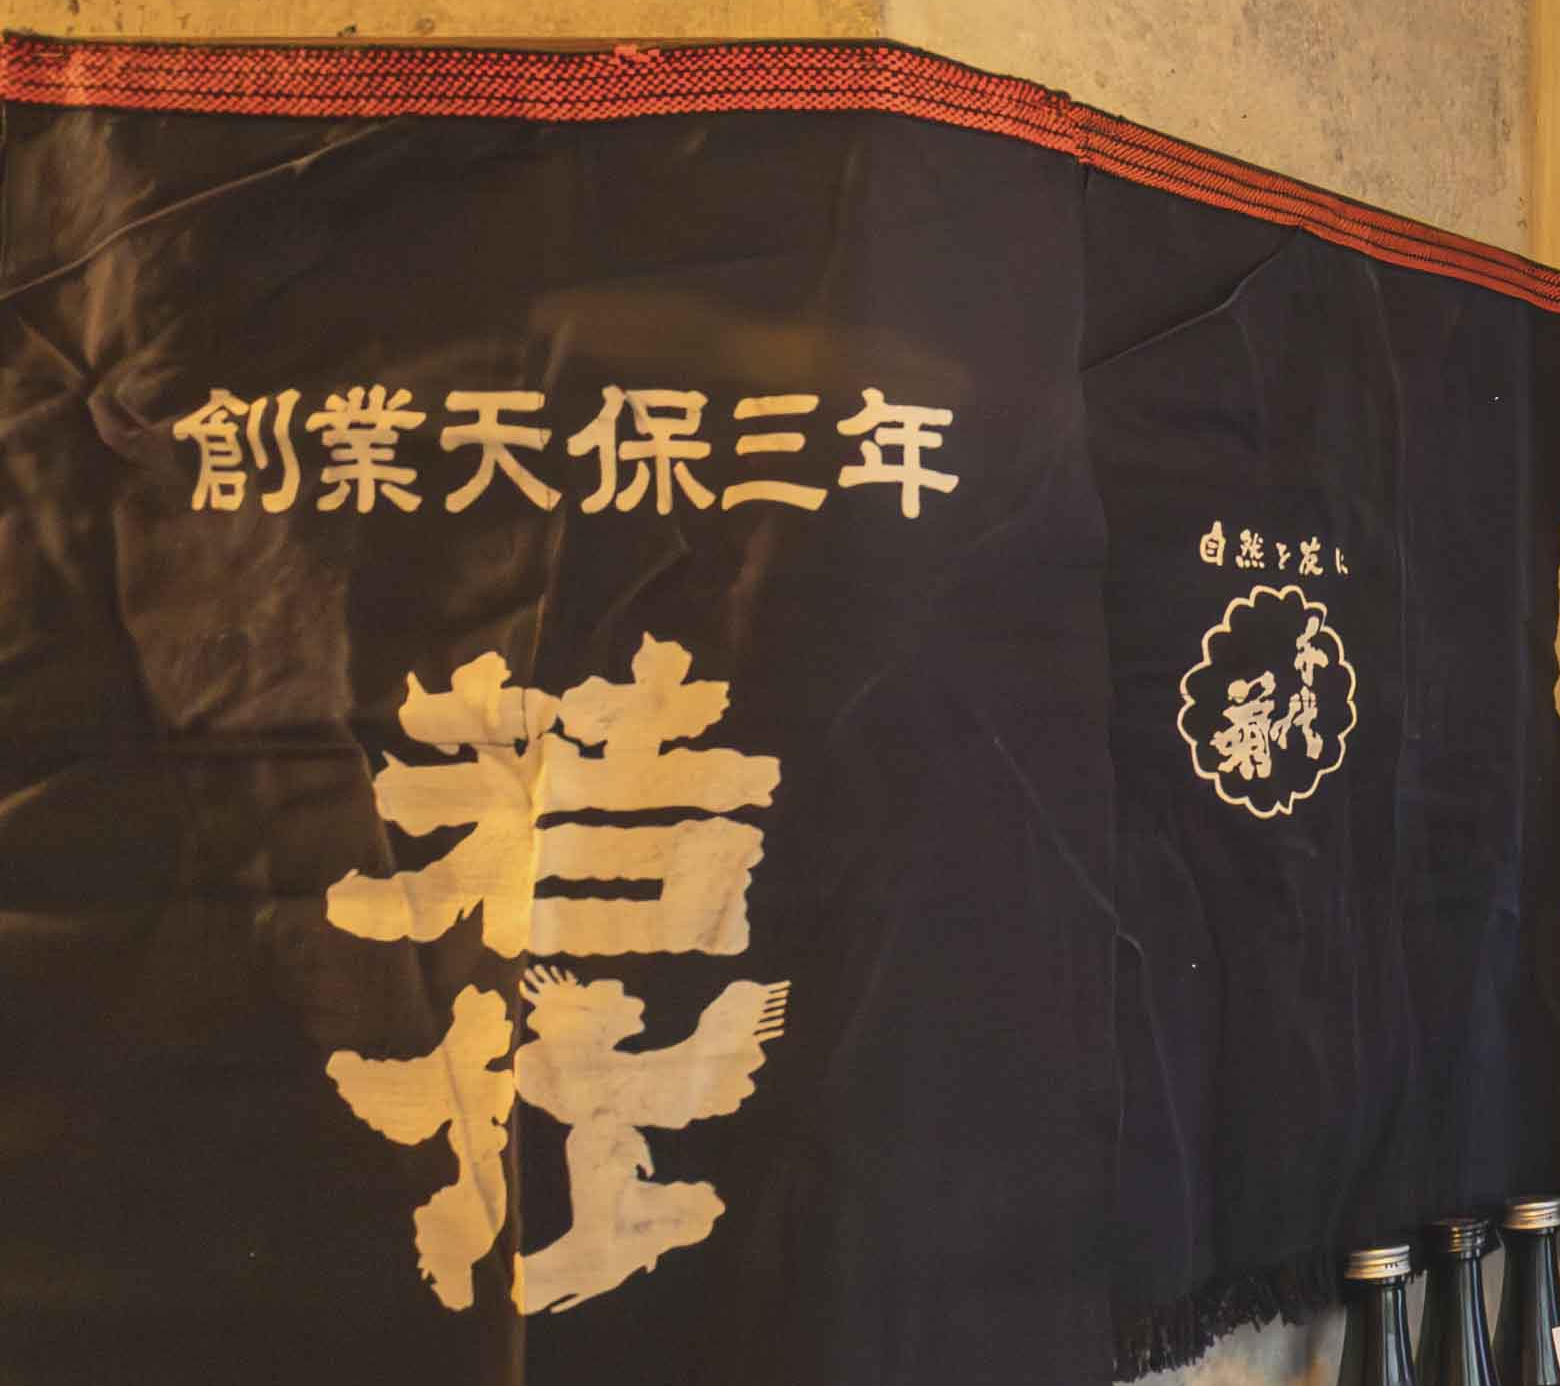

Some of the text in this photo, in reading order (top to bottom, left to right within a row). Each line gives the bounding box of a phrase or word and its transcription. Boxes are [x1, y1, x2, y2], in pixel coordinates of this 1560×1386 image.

[172, 387, 961, 518] 創業天保三年
